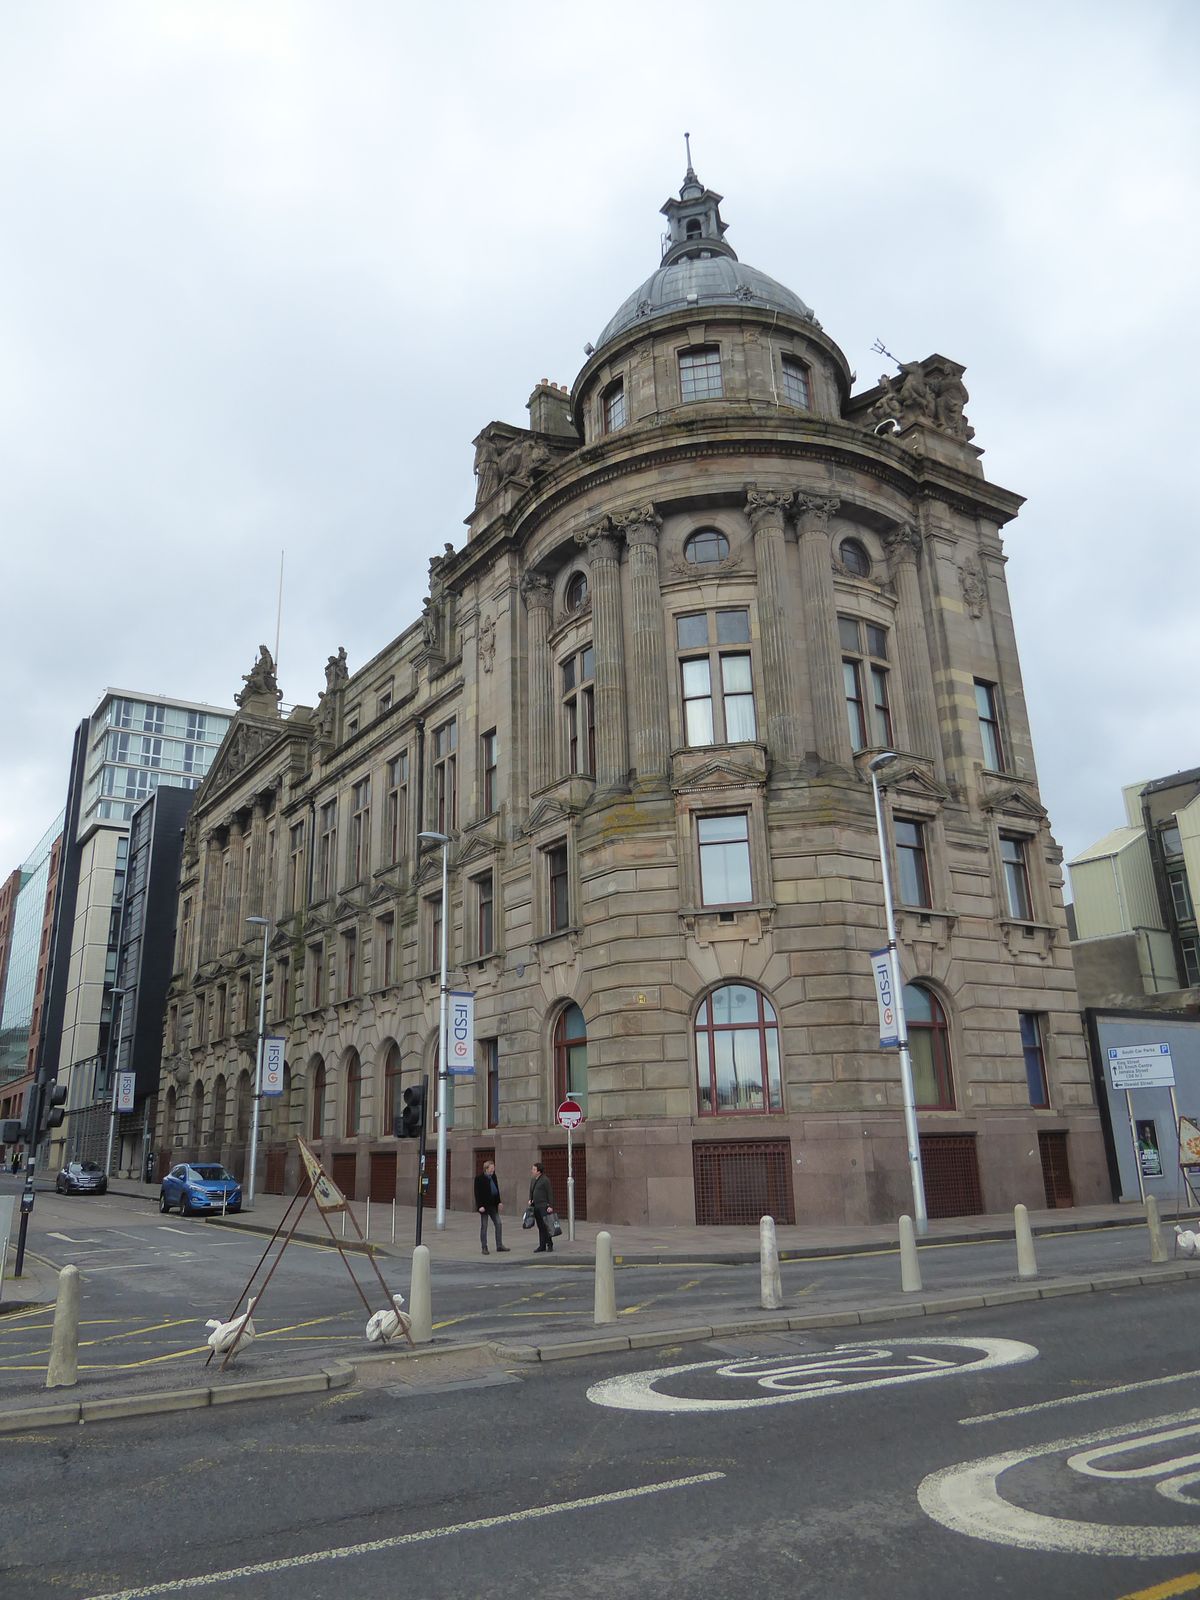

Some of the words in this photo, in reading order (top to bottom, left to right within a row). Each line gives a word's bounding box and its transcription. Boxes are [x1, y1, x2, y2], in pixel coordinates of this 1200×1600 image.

[877, 964, 891, 1006] IFSD
[454, 1004, 467, 1040] IFSD
[268, 1045, 280, 1072] IFSD
